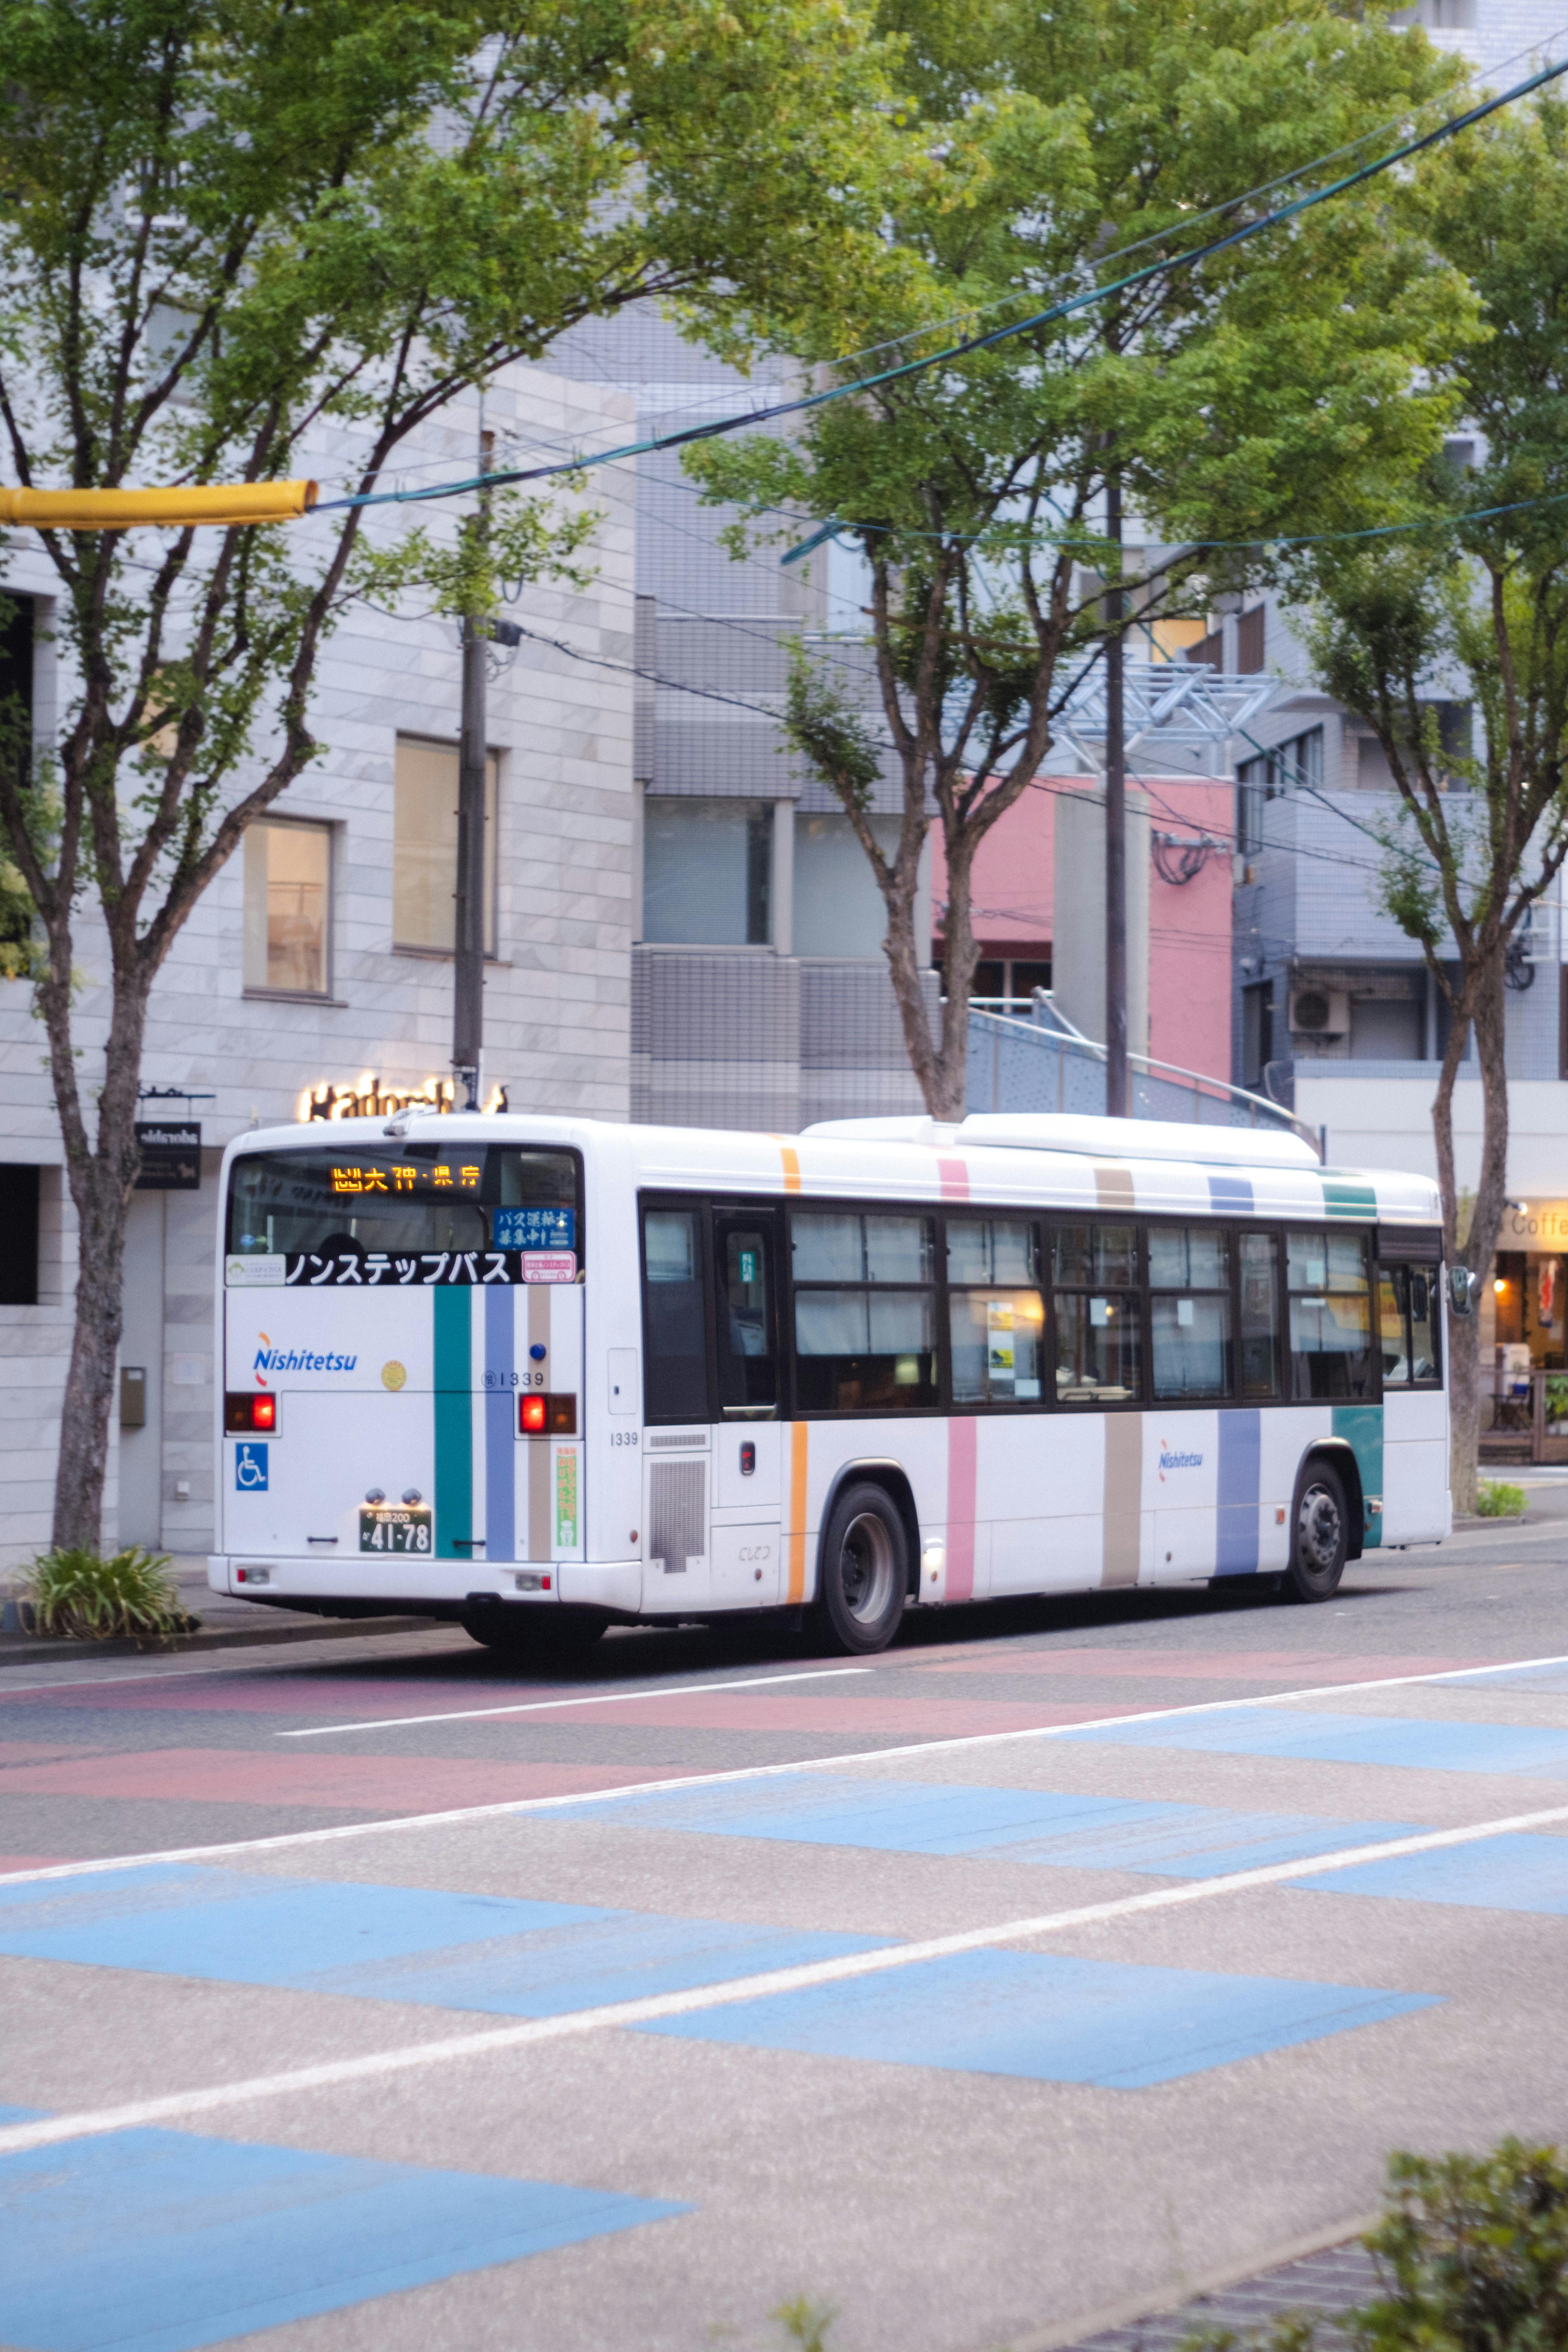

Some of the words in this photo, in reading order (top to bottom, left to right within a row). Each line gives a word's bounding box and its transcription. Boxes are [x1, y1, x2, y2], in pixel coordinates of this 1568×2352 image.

[286, 1252, 510, 1284] ノンステップバス
[253, 1349, 357, 1370] Nishitetsu
[501, 1372, 543, 1386] 1339
[611, 1432, 638, 1446] 1339
[1158, 1452, 1203, 1469] Nishitetsu
[392, 1513, 410, 1523] 200
